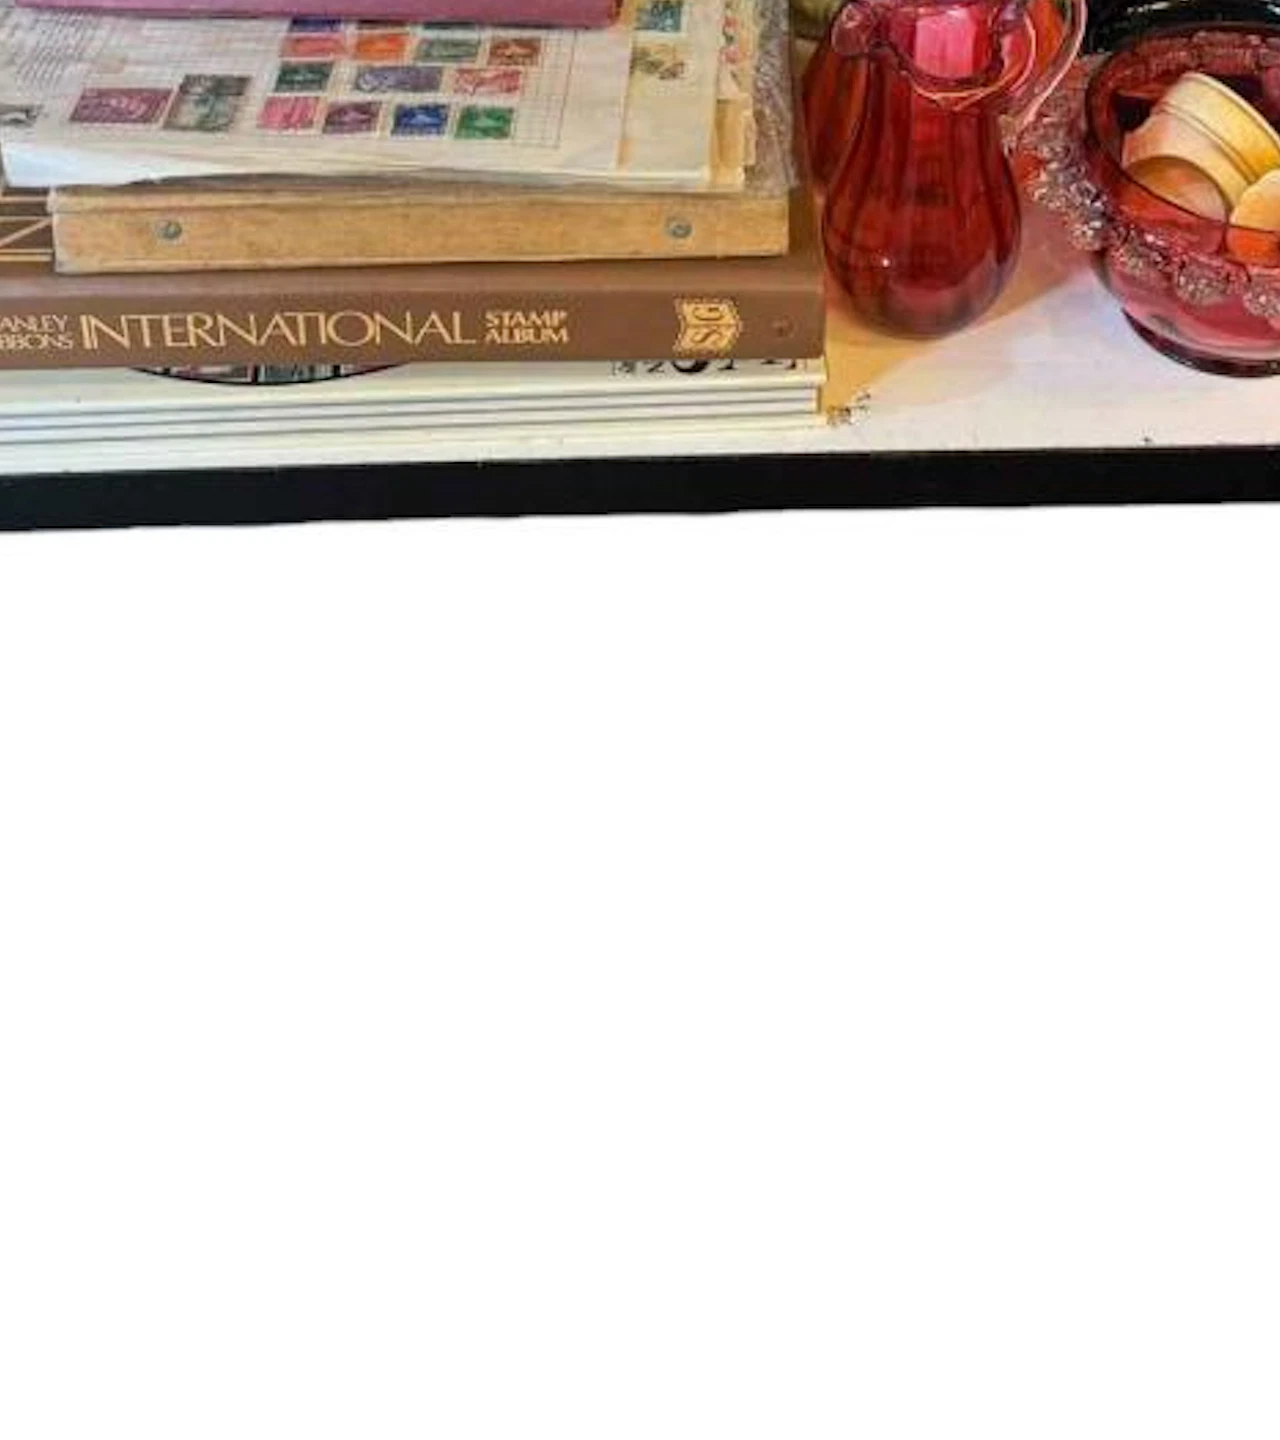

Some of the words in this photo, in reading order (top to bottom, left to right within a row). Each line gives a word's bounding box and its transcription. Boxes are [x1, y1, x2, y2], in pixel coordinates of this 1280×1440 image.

[484, 311, 569, 328] STAMP
[79, 310, 477, 350] INTERNATIONAL
[484, 327, 570, 344] ALBUM
